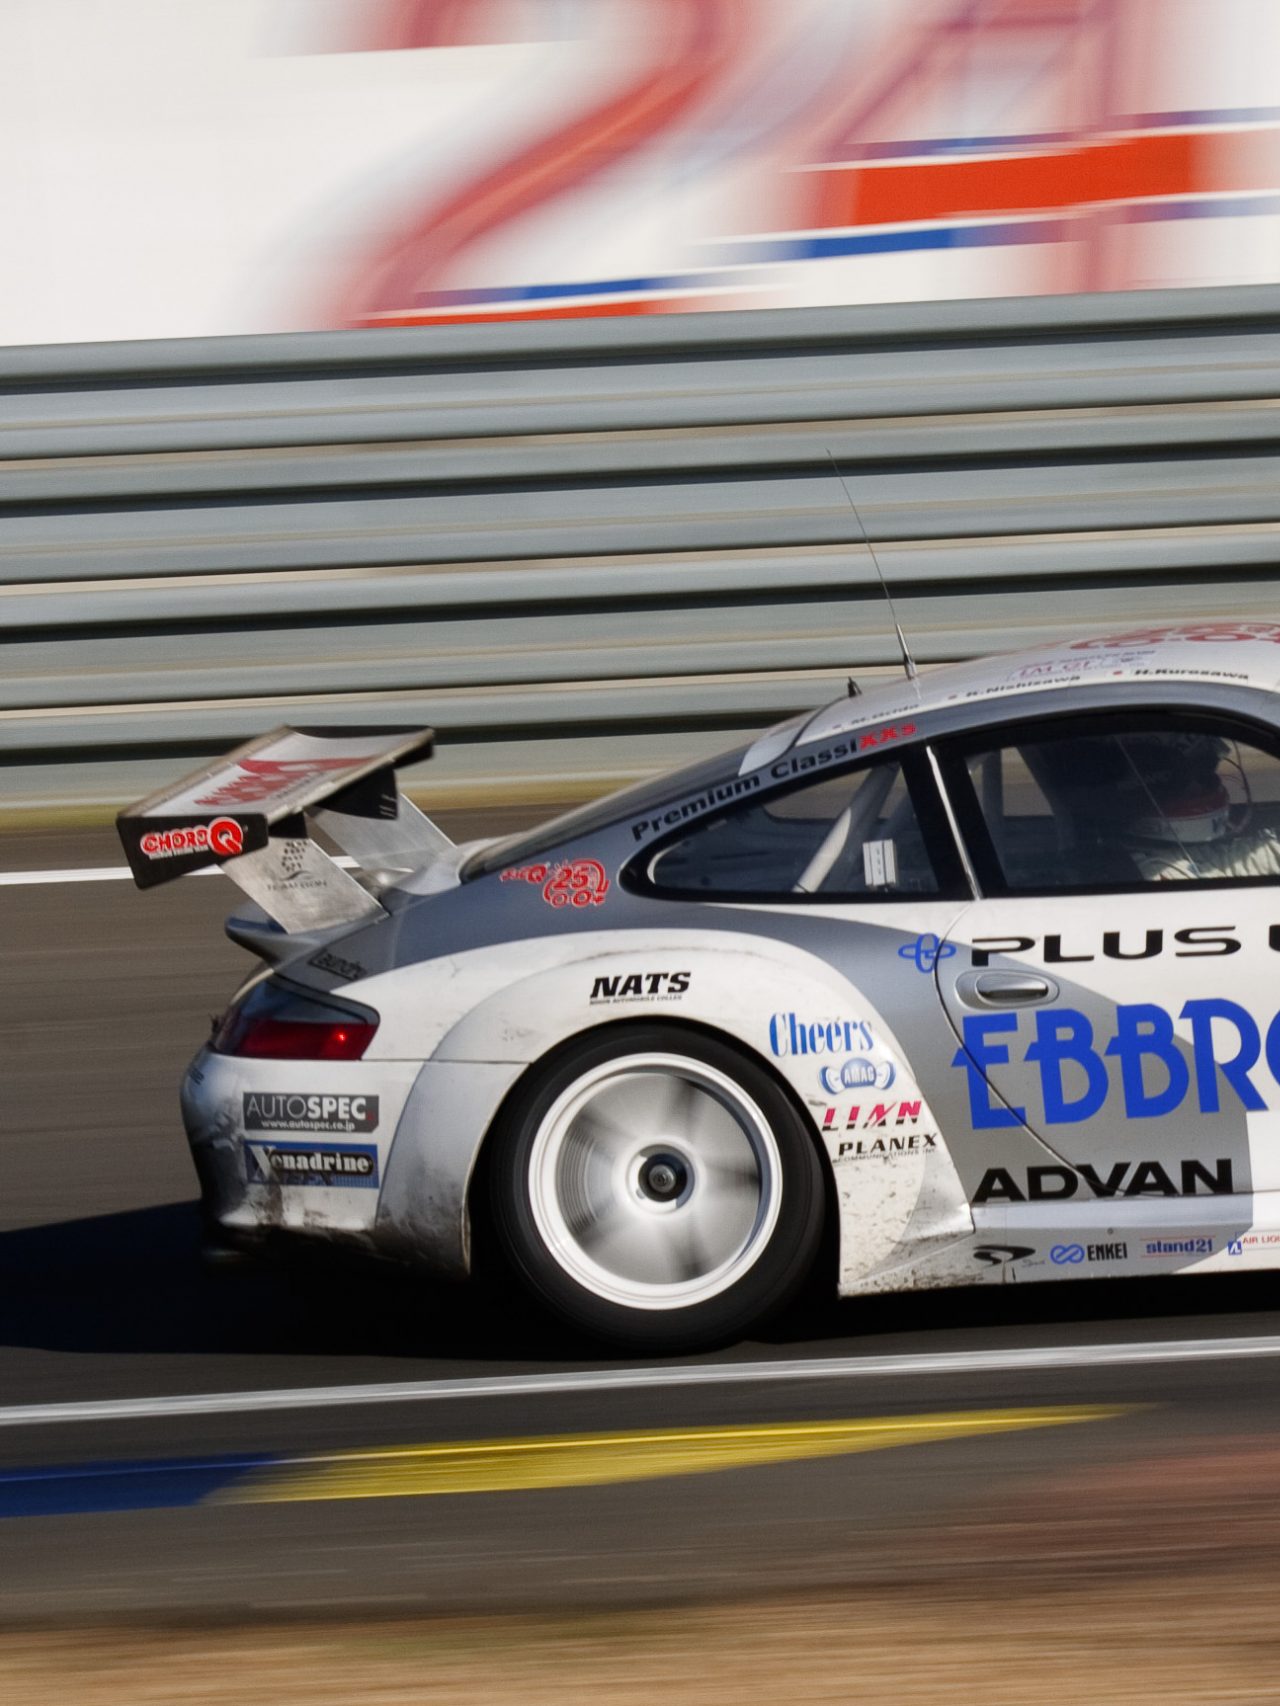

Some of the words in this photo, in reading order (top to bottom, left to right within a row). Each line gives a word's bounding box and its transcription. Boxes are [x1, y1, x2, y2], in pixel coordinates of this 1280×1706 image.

[630, 774, 761, 843] Premium
[971, 926, 1242, 967] PLUS
[590, 971, 691, 999] NATS
[769, 1012, 874, 1057] Cheers
[246, 1096, 367, 1120] AUTOSPEC
[261, 1119, 356, 1131] www.autospec.co.jp
[838, 1133, 937, 1156] PLANEX
[973, 1159, 1233, 1203] ADVAN
[1087, 1243, 1128, 1262] ENKEI
[1242, 1236, 1258, 1244] AIR
